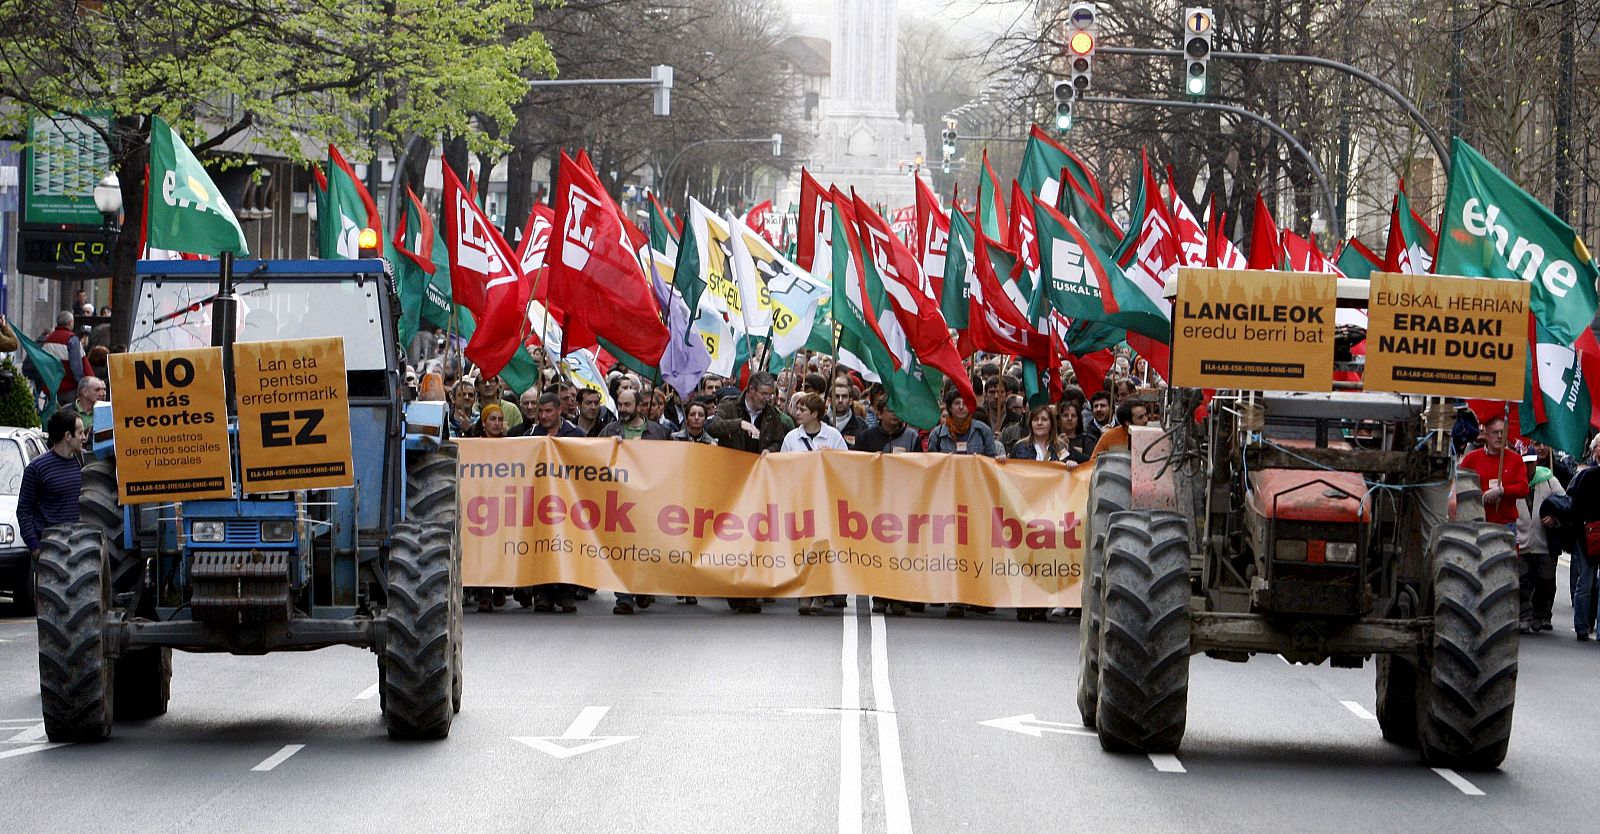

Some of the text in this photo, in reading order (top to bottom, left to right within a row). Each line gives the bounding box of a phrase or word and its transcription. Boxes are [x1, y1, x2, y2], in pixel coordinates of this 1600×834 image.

[1462, 197, 1578, 298] ehne
[1053, 280, 1091, 295] EUSKAL
[1183, 301, 1324, 324] LANGILEOK
[1376, 292, 1523, 314] EUSKAL HERRIAN
[1183, 323, 1324, 344] eredu berri bat
[1393, 313, 1502, 337] ERABAKI
[1378, 335, 1514, 361] NAHI DUGU
[134, 357, 195, 391] NO
[257, 356, 317, 373] Lan eta
[259, 372, 318, 389] pentsio
[146, 391, 191, 409] más
[241, 386, 338, 406] erreformarik
[124, 410, 215, 428] recortes
[260, 408, 328, 448] EZ
[140, 431, 203, 444] en nuestros
[125, 441, 221, 456] derechos sociales
[144, 455, 202, 469] y laborales
[534, 462, 629, 483] aurrean
[657, 503, 816, 542] eredu
[837, 499, 968, 545] berri
[991, 507, 1082, 550] bat
[504, 534, 1081, 579] no más recortes en nuestros derechos sociales y laborales
